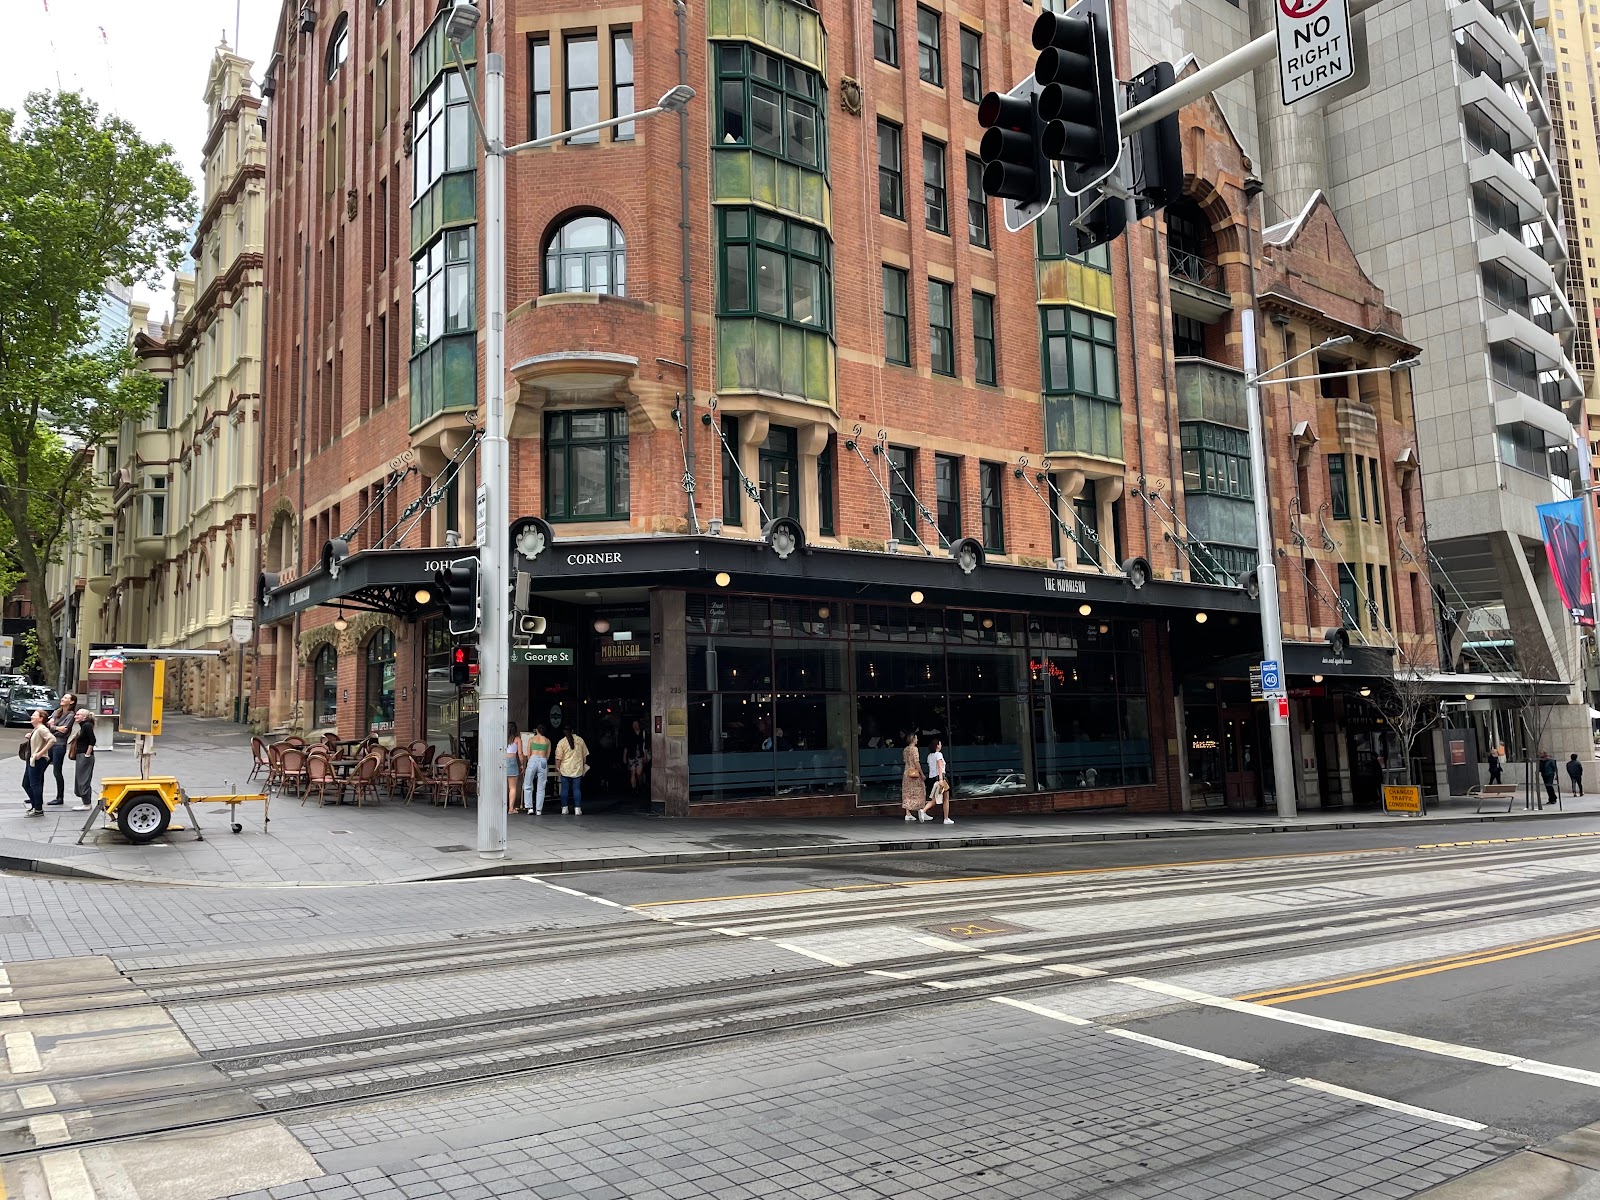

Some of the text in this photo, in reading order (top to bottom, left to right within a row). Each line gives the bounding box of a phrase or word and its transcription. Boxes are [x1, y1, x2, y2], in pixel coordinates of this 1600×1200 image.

[1294, 15, 1330, 49] NO
[1287, 35, 1341, 74] RIGHT
[1291, 57, 1342, 91] TURN
[567, 552, 622, 565] CORNER
[1044, 577, 1056, 592] THE
[524, 652, 569, 663] George St
[601, 644, 640, 658] MORRISON
[1266, 676, 1276, 684] 40
